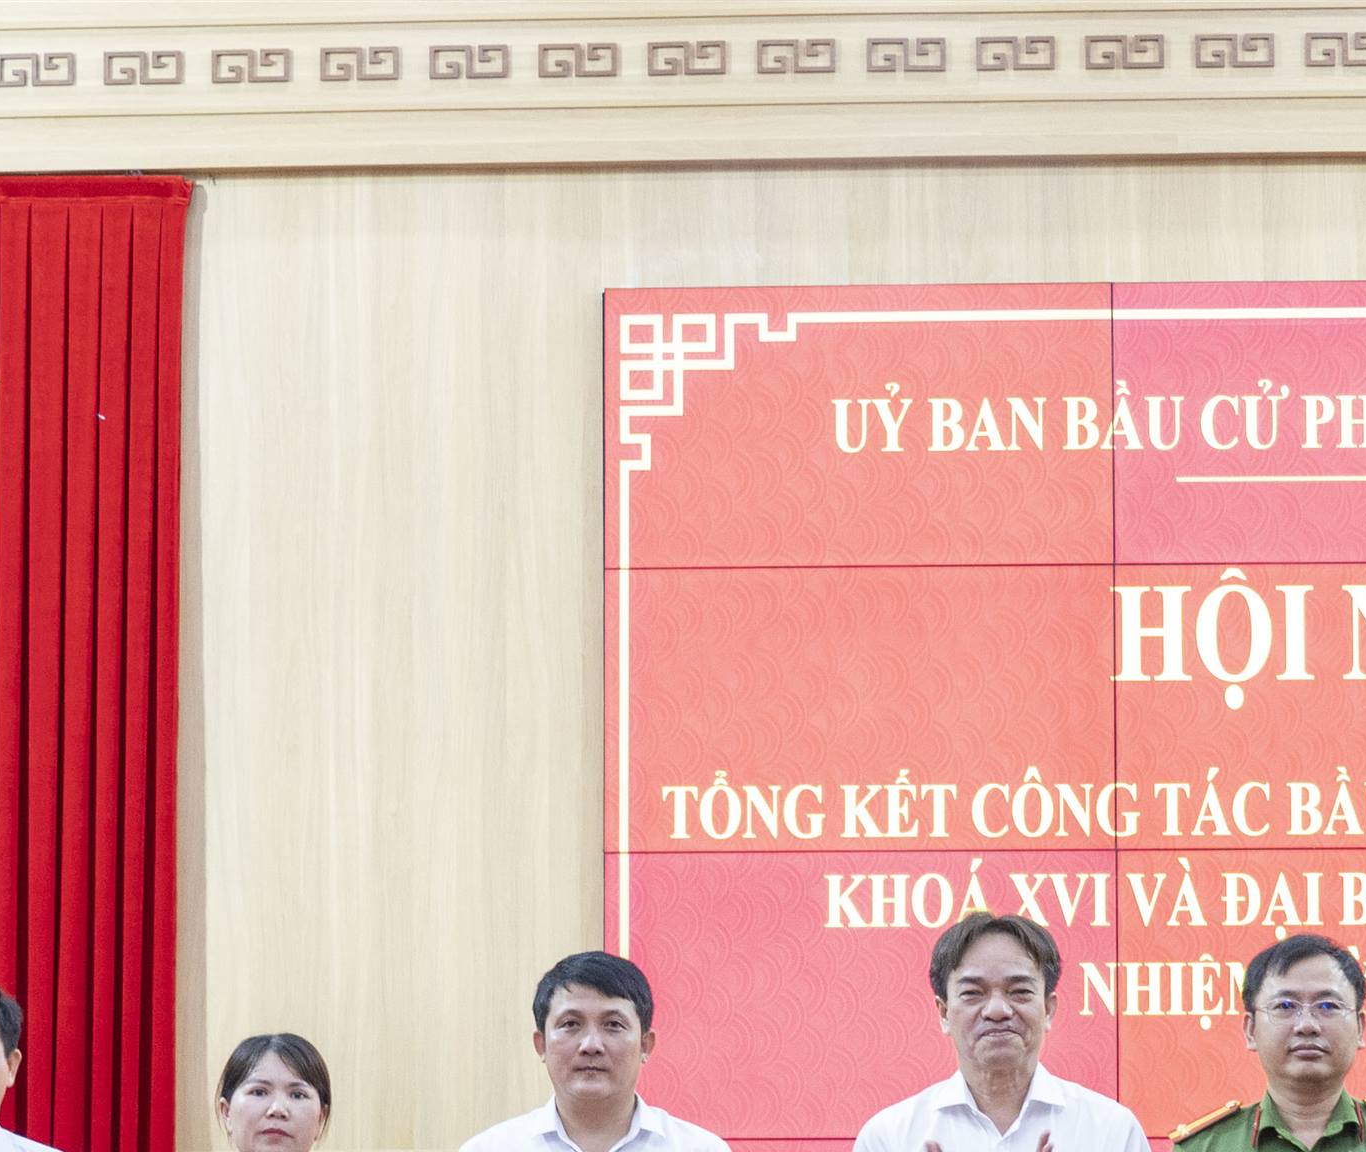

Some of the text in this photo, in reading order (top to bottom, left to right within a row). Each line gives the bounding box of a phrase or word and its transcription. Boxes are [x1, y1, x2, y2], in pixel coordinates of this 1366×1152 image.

[831, 382, 913, 454] UỶ
[927, 397, 1047, 452] BAN
[1062, 379, 1184, 451] BẦU
[1200, 379, 1289, 450] CỬ
[1109, 567, 1315, 710] HỘI
[661, 770, 826, 840] TỔNG
[840, 768, 957, 839] KẾT
[971, 765, 1141, 839] CÔNG
[1154, 766, 1270, 837] TÁC
[824, 857, 988, 929] KHOÁ
[1009, 873, 1111, 928] XVI
[1126, 857, 1208, 927] VÀ
[1221, 871, 1324, 941] ĐẠI
